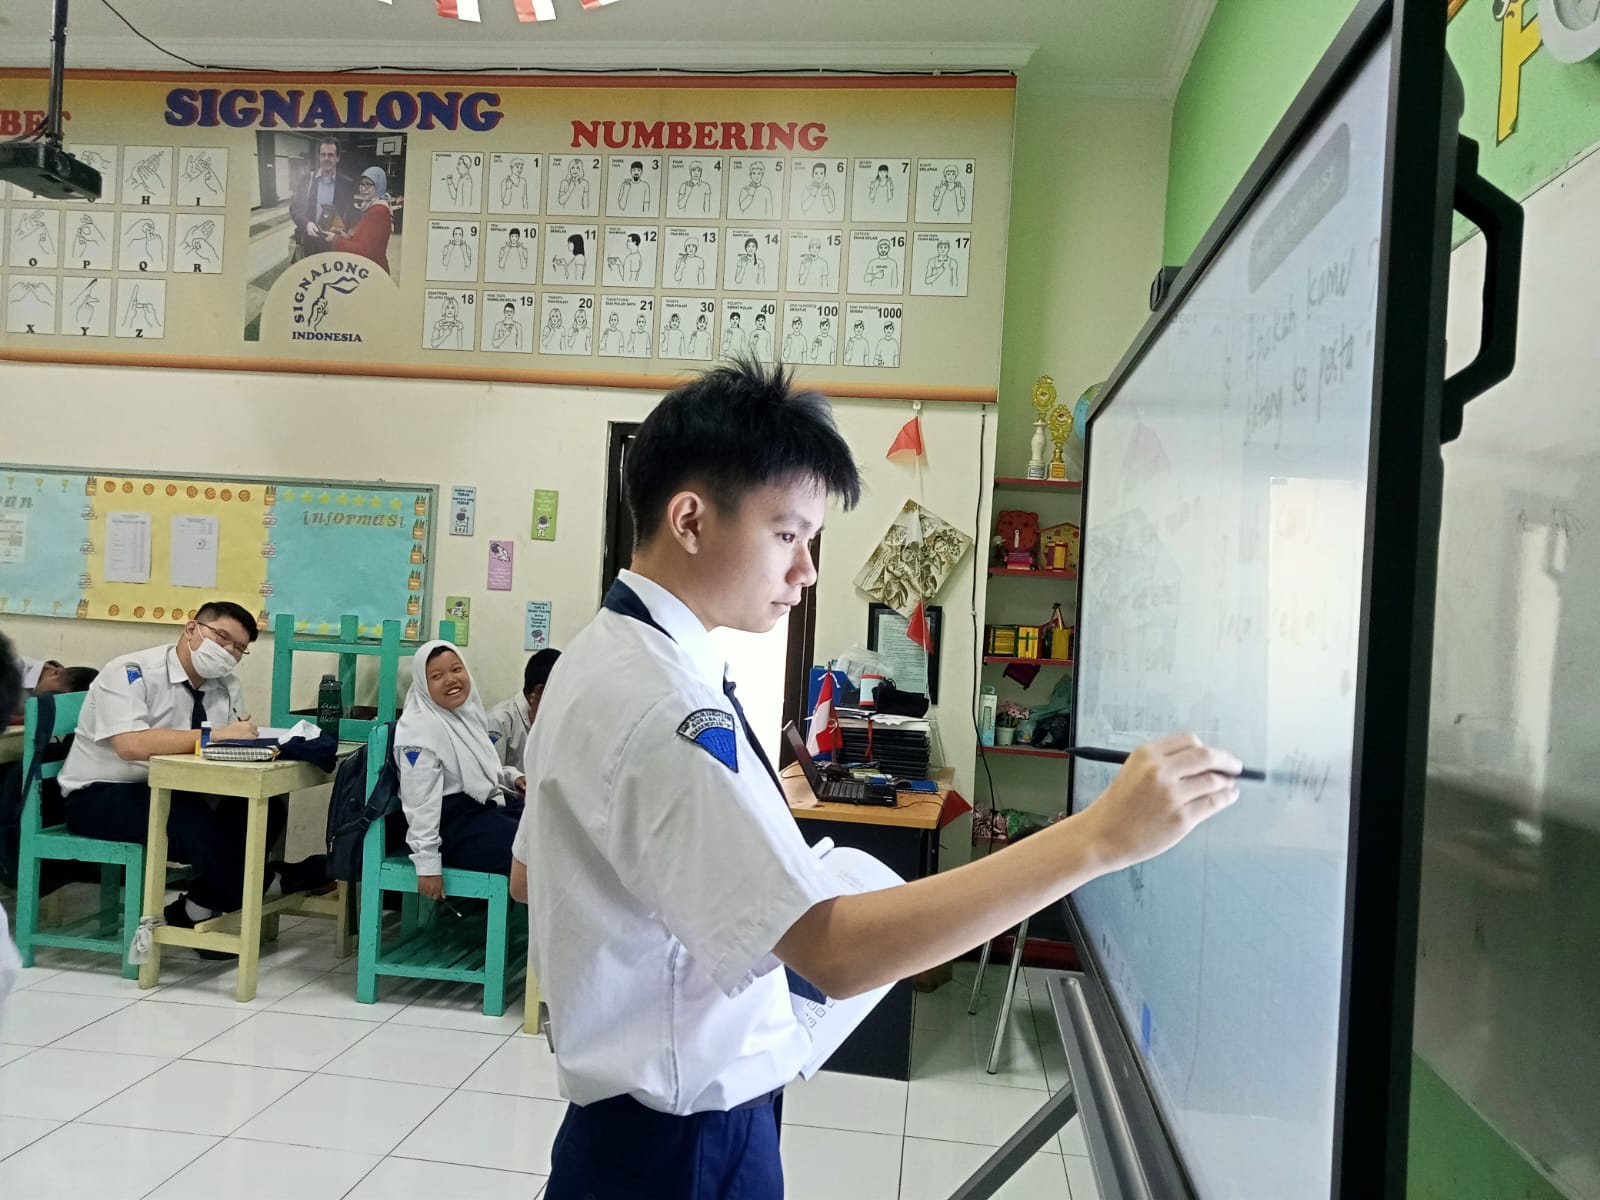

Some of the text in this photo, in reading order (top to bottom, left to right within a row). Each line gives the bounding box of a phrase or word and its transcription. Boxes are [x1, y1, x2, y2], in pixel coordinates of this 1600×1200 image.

[165, 88, 504, 131] SIGNALONG
[0, 110, 71, 137] BE
[570, 120, 828, 151] NUMBERING
[474, 156, 480, 166] 0
[534, 158, 538, 168] 1
[592, 158, 600, 168] 2
[652, 160, 658, 170] 3
[714, 160, 722, 170] 4
[776, 160, 782, 172] 5
[836, 162, 844, 172] 6
[902, 162, 910, 174] 7
[966, 164, 972, 174] 8
[142, 196, 150, 205] H
[196, 197, 200, 206] I
[470, 226, 478, 236] 9
[524, 228, 536, 238] 10
[584, 230, 596, 240] 11
[644, 230, 656, 242] 12
[702, 232, 716, 242] 13
[766, 234, 778, 244] 14
[826, 234, 840, 246] 15
[890, 236, 904, 248] 16
[956, 238, 970, 250] 17
[28, 258, 38, 267] O
[83, 260, 90, 270] P
[139, 261, 148, 272] Q
[194, 264, 202, 273] R
[293, 261, 369, 324] SIGNALONG
[462, 294, 474, 304] 18
[520, 296, 534, 306] 19
[578, 298, 592, 308] 20
[640, 300, 652, 310] 21
[700, 302, 714, 312] 30
[760, 304, 774, 314] 40
[818, 306, 838, 316] 100
[878, 308, 902, 318] 1000
[26, 325, 35, 334] X
[81, 327, 90, 336] Y
[136, 330, 144, 338] Z
[292, 331, 363, 342] INDONESIA
